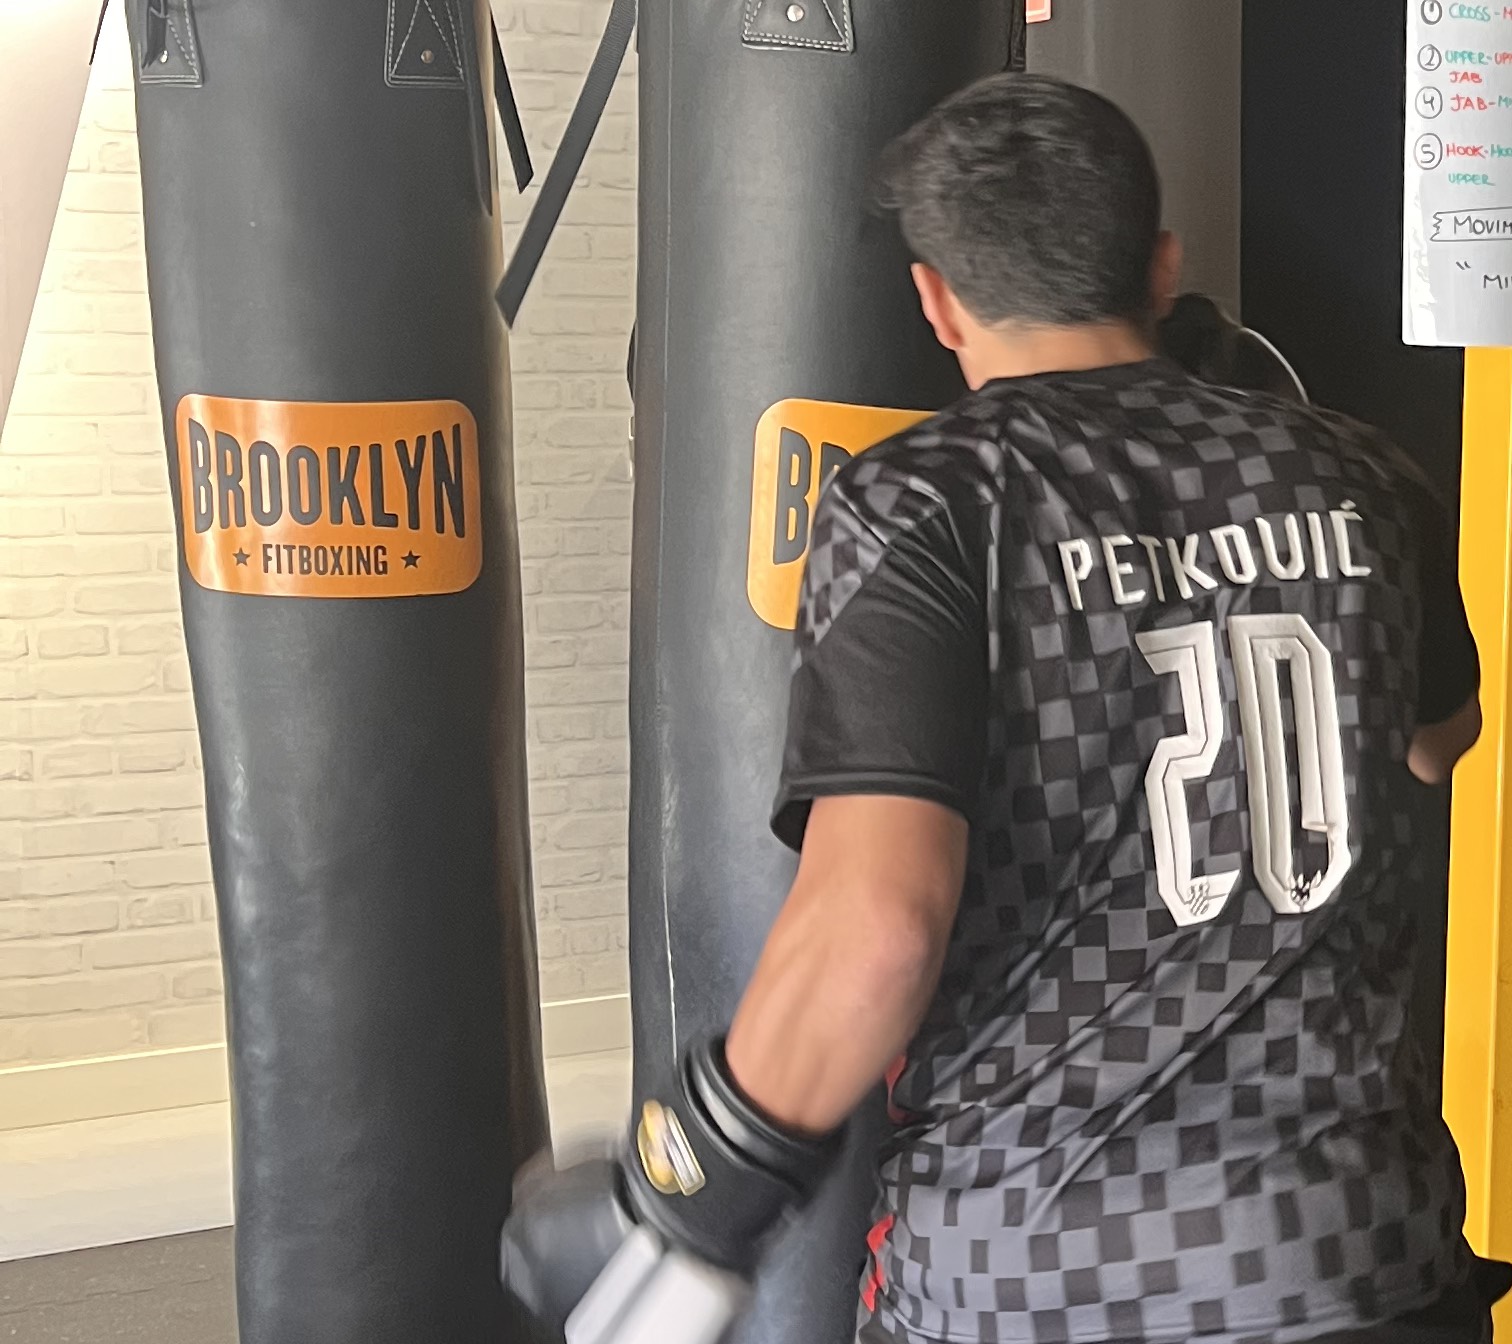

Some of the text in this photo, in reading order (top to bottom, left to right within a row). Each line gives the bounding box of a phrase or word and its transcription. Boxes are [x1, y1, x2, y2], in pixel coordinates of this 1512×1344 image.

[188, 418, 466, 539] BROOKLYN
[262, 543, 388, 576] FITBOXING
[1135, 613, 1352, 927] 20
